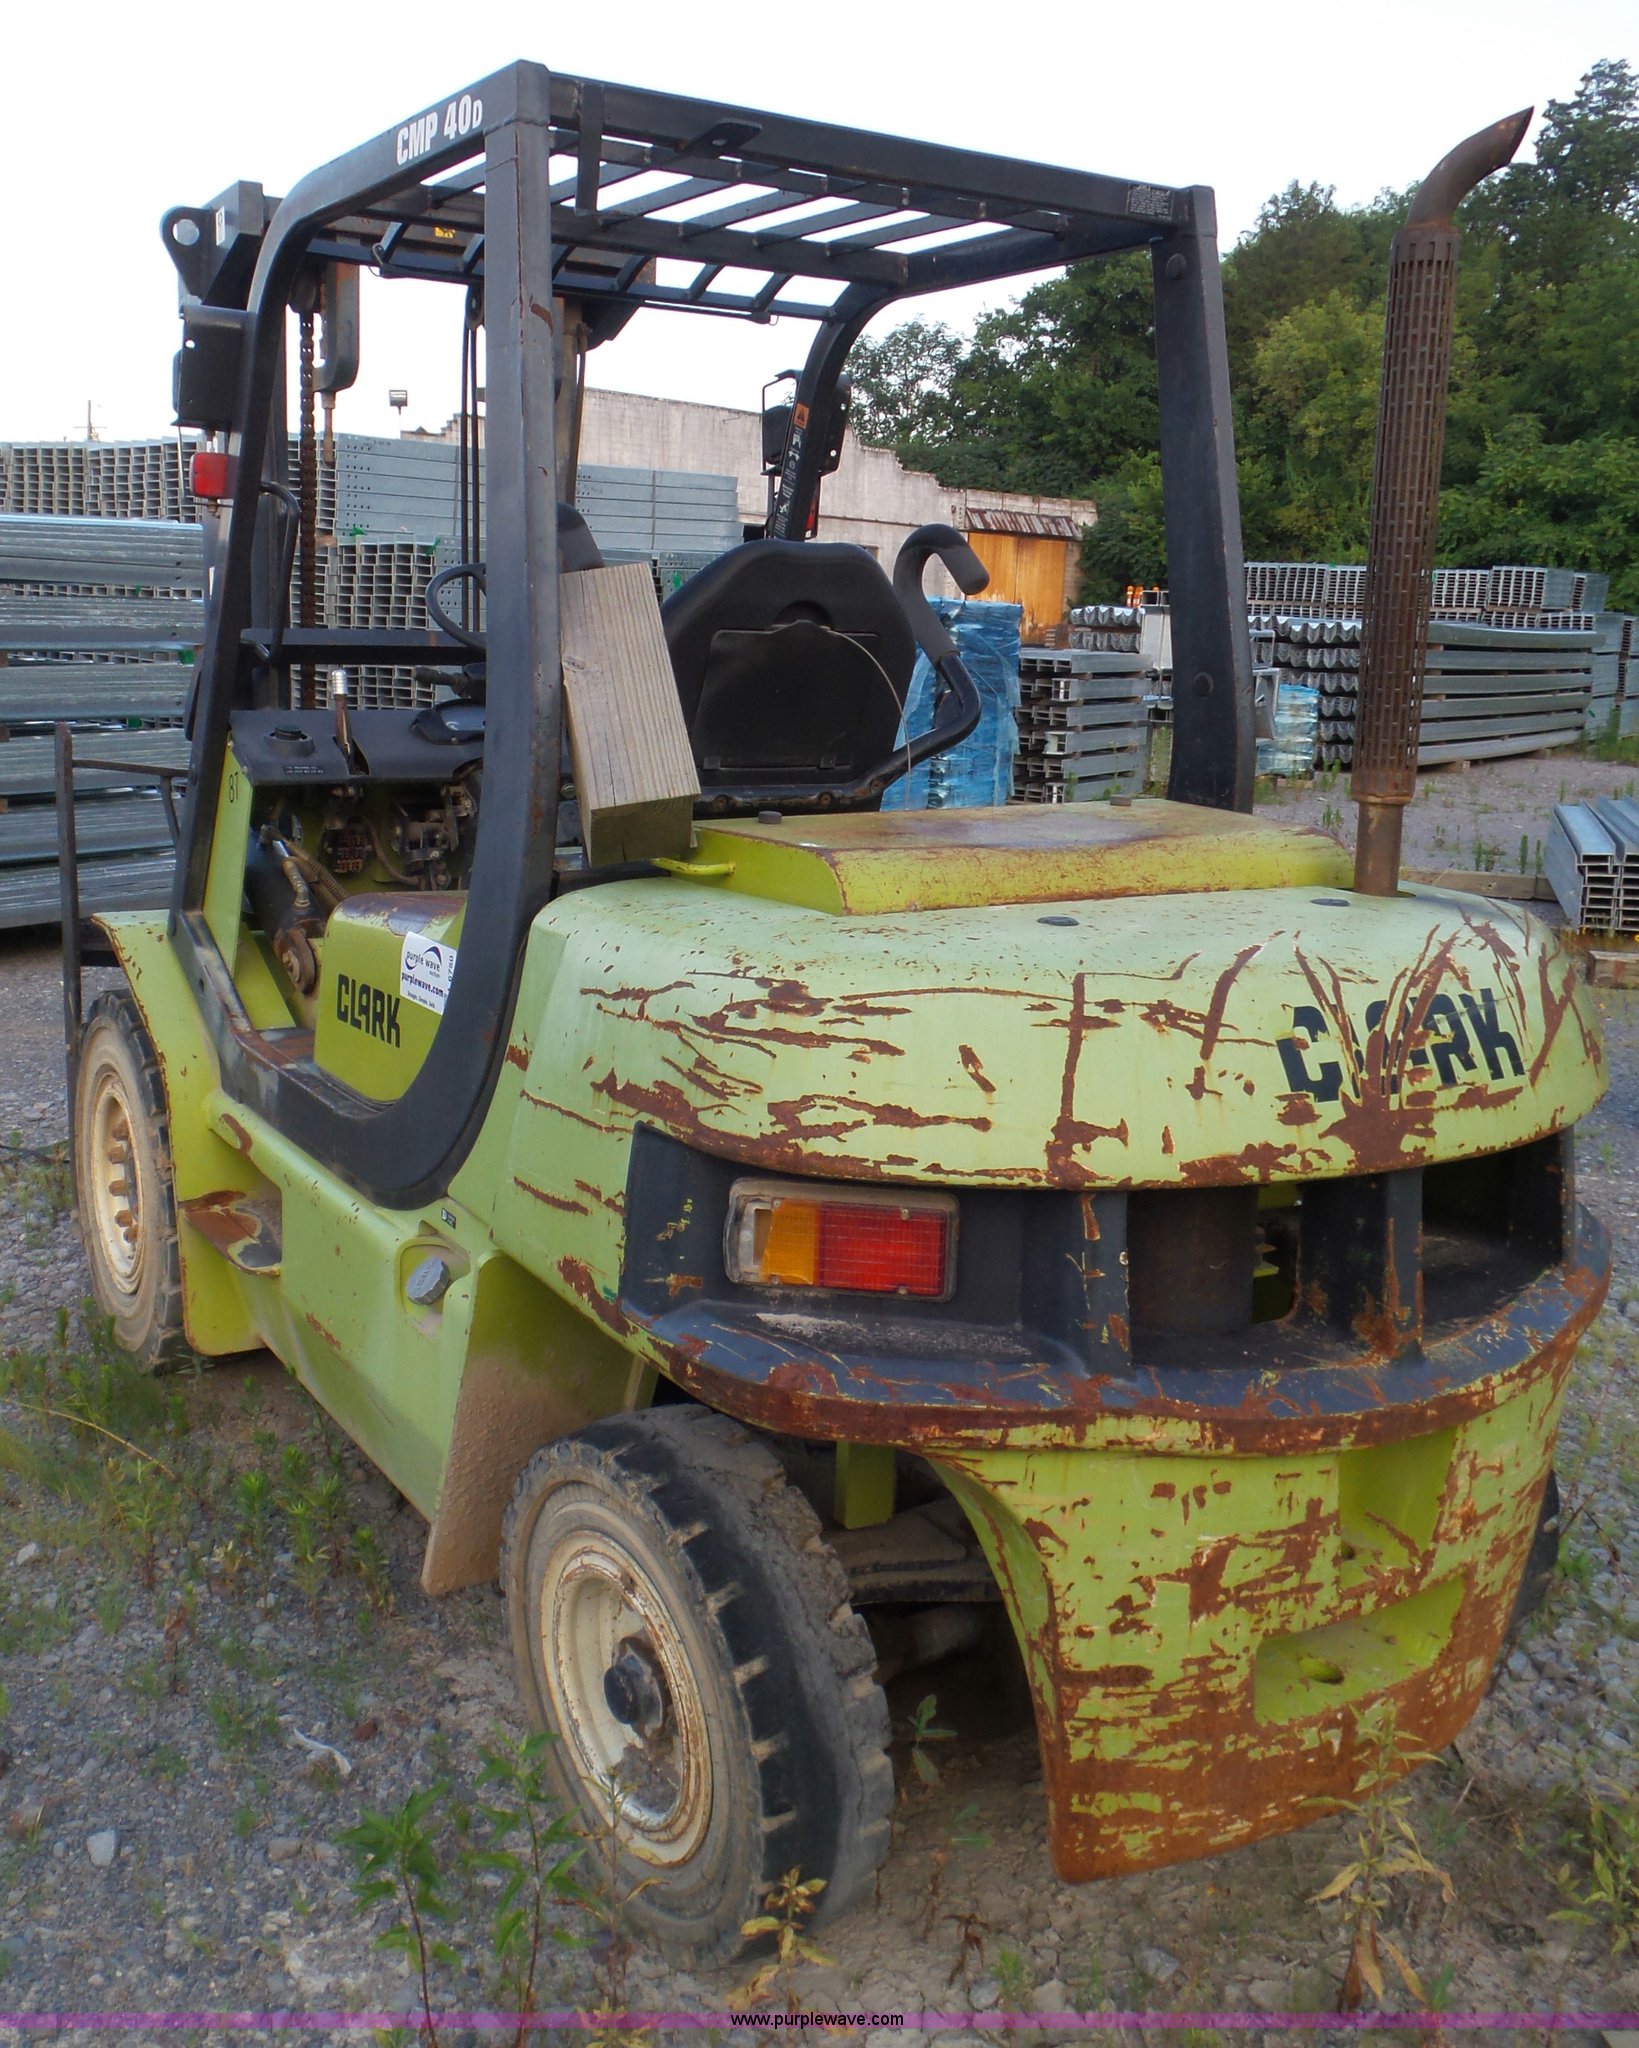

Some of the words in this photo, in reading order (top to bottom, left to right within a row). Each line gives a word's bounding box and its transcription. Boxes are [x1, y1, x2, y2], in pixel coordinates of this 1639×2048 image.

[396, 111, 439, 166] CMP
[443, 94, 483, 140] 40D
[401, 972, 444, 998] purplewave.com
[425, 958, 441, 972] wave
[336, 973, 401, 1049] CLARK
